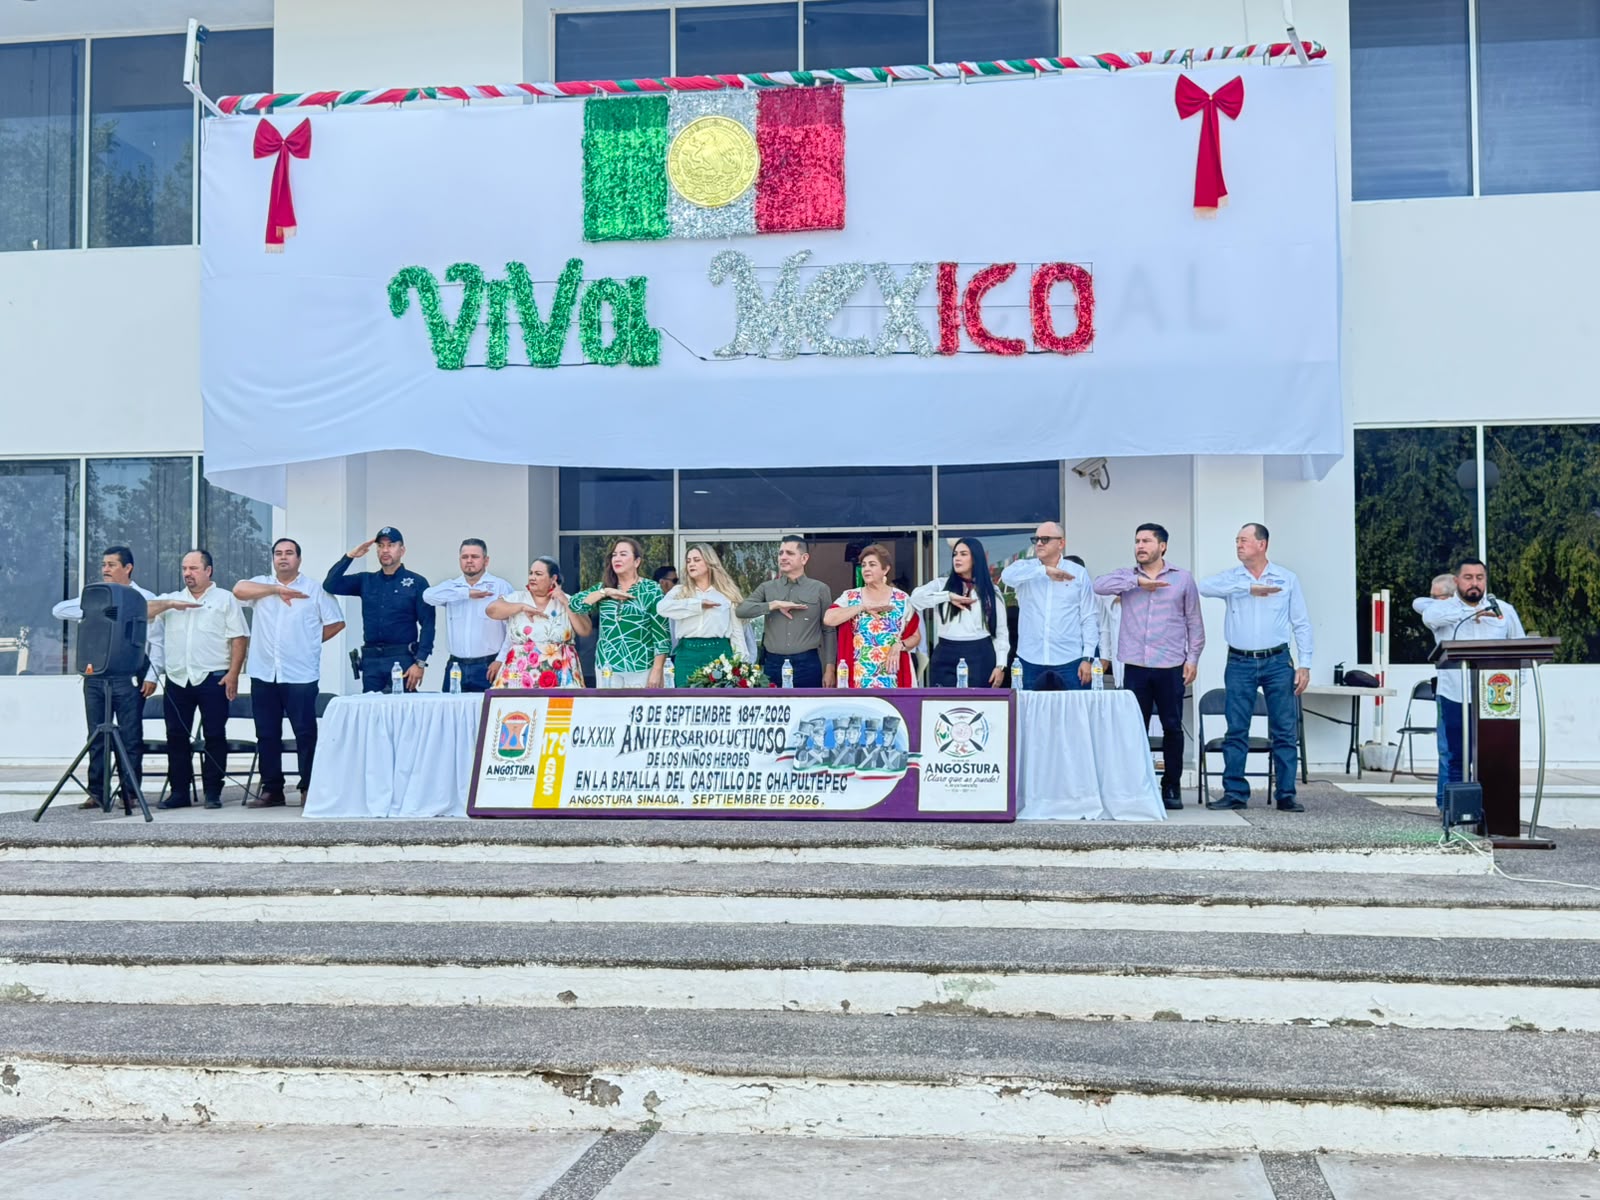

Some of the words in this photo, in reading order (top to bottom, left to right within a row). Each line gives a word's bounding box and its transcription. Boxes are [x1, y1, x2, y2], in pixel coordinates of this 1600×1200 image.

[630, 705, 644, 723] 13
[647, 705, 662, 723] DE
[665, 705, 731, 723] SEPTIEMBRE
[738, 705, 791, 723] 1847-2026
[572, 725, 616, 745] CLXXIX
[647, 751, 661, 766] DE
[661, 751, 679, 766] LOS
[680, 748, 712, 767] NIÑOS
[713, 751, 750, 767] HEROES
[486, 764, 535, 776] ANGOSTURA
[925, 762, 1000, 774] ANGOSTURA
[575, 770, 591, 789] EN
[592, 770, 608, 789] LA
[611, 770, 660, 789] BATALLA
[665, 770, 686, 790] DEL
[690, 770, 746, 790] CASTILLO
[746, 771, 762, 790] DE
[766, 771, 848, 791] CHAPULTEPEC
[569, 794, 633, 805] ANGOSTURA
[692, 793, 767, 805] SEPTIEMBRE
[769, 793, 785, 805] DE
